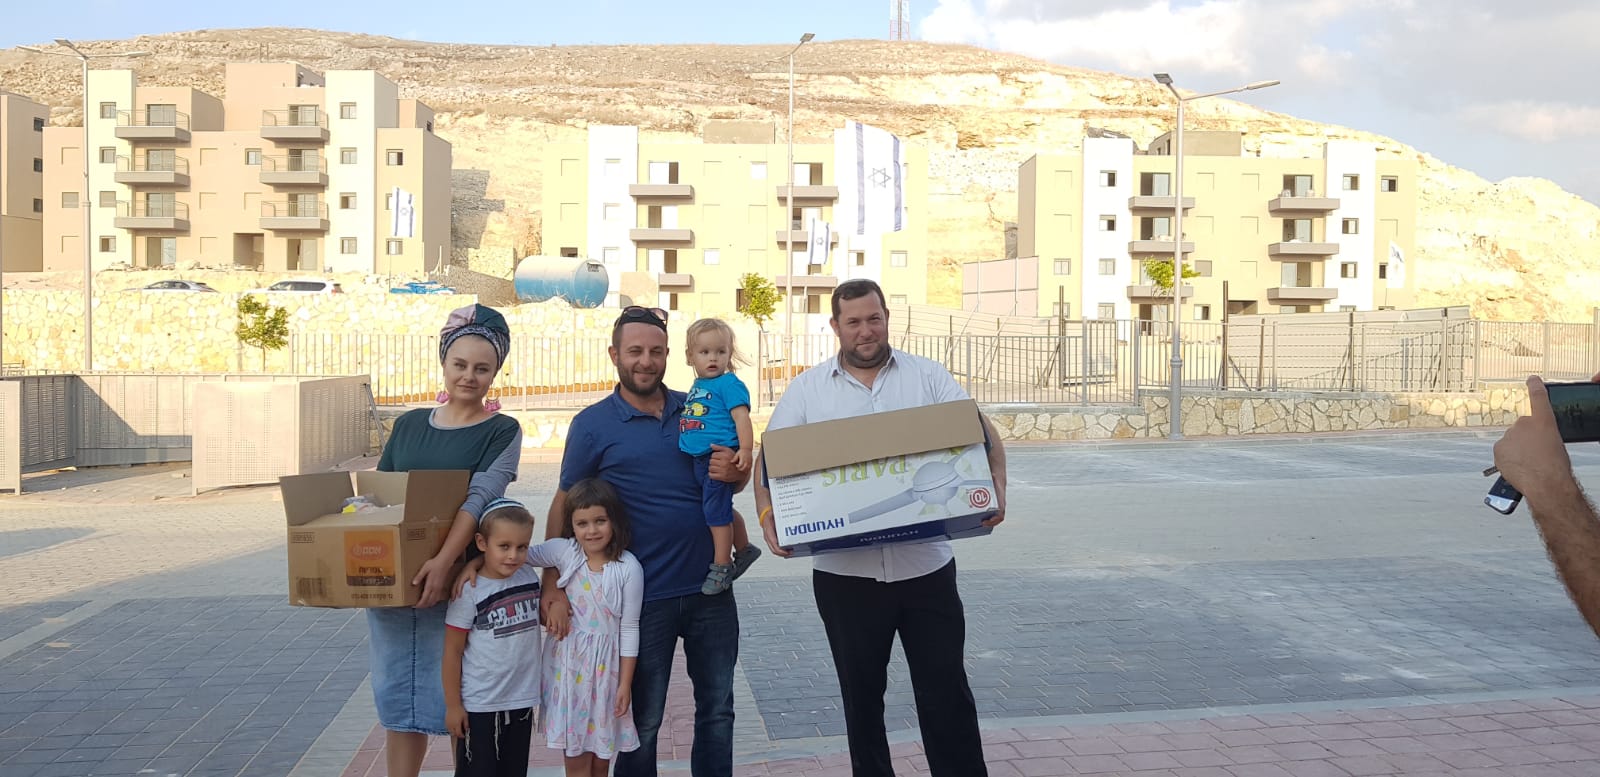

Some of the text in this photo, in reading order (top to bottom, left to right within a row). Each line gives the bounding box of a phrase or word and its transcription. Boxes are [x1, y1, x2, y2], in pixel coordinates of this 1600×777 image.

[821, 455, 909, 488] PARIS
[974, 491, 987, 503] 10
[784, 517, 845, 537] HYUNDAI
